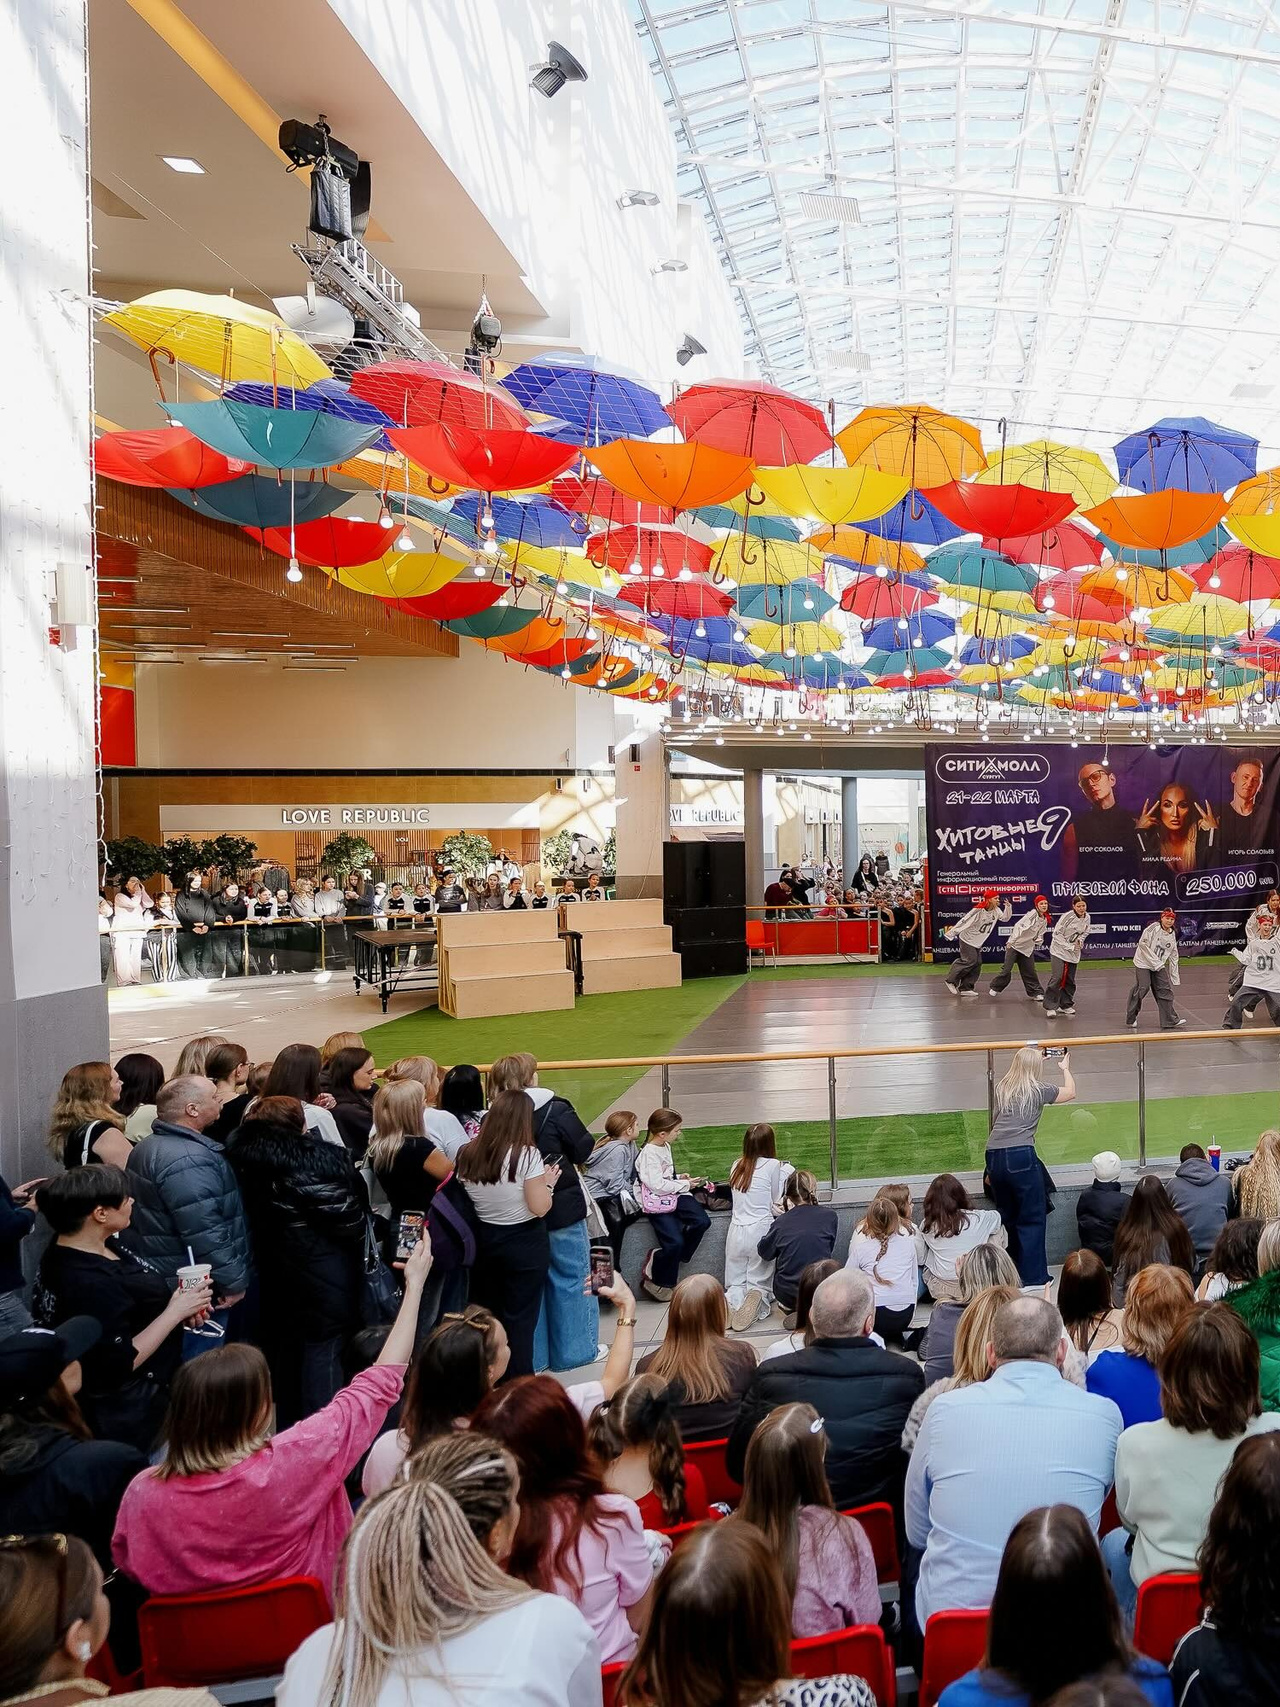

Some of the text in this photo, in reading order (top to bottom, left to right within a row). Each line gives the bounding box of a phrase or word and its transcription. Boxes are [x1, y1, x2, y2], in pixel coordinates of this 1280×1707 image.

[945, 760, 1041, 772] СИТИ МОЛЛ
[945, 789, 1041, 805] 21-22 МАРТА
[282, 808, 430, 825] LOVE REPUBLIC
[935, 819, 1040, 853] ХИТОВЫЕ
[959, 837, 1026, 865] ТАНЦЫ
[1052, 879, 1170, 896] ПРИЗОВОЙ ФОНД
[1185, 870, 1257, 896] 250.000
